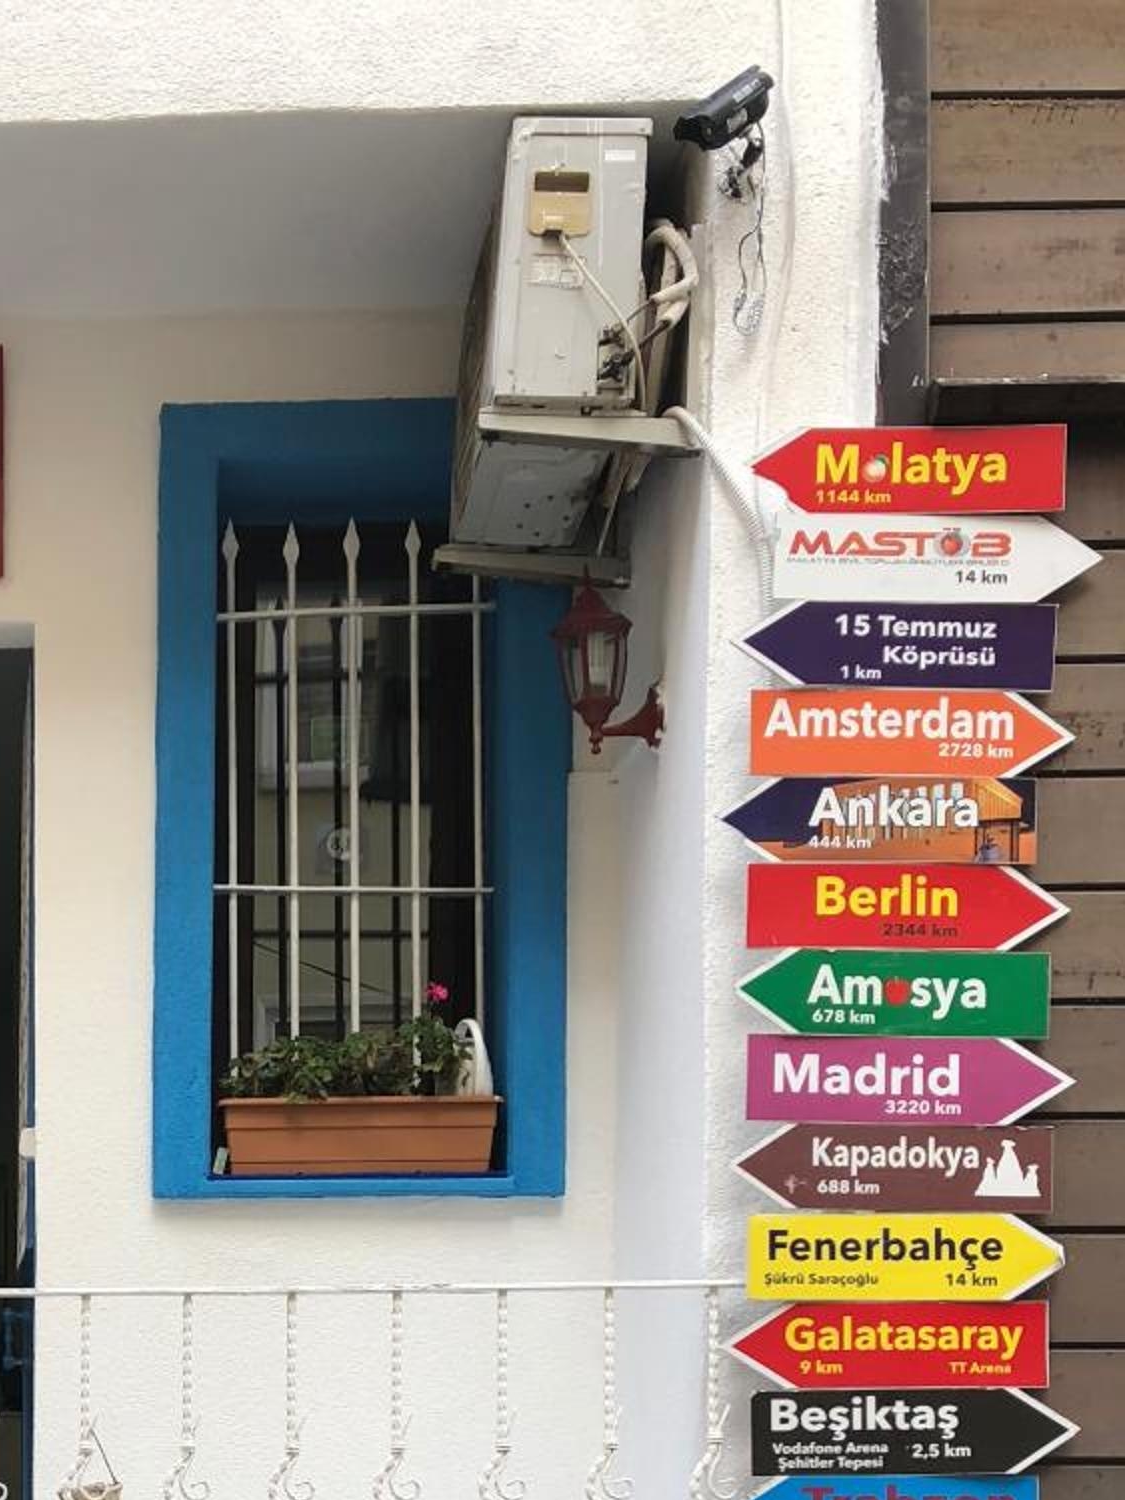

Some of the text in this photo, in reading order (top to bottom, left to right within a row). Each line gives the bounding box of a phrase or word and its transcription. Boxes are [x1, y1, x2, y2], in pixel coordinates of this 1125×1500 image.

[816, 441, 1008, 496] Mlatya
[816, 490, 892, 504] 1144 km
[955, 569, 1008, 584] 14 km
[835, 614, 998, 640] 15 Temmuz
[882, 643, 996, 671] Köprüsü
[840, 666, 882, 680] 1 km
[764, 696, 1015, 741] Amsterdam
[938, 743, 1015, 758] 2728 km
[807, 784, 980, 828] Ankara
[808, 834, 872, 849] 444 km
[815, 873, 958, 917] Berlin
[882, 923, 958, 938] 2344 km
[806, 963, 987, 1020] Amsya
[812, 1010, 876, 1025] 678 km
[772, 1052, 961, 1097] Madrid
[884, 1100, 962, 1116] 3220 km
[811, 1136, 980, 1177] Kapadokya
[817, 1179, 880, 1194] 688 km
[767, 1228, 1004, 1271] Fenerbahçe
[946, 1273, 998, 1287] 14 km
[784, 1315, 1024, 1360] Galatasaray
[798, 1360, 843, 1375] 9 km
[948, 1362, 1012, 1375] TT Arena
[770, 1396, 959, 1440] Beşiktaş
[772, 1442, 888, 1456] Vodafone Arena
[911, 1443, 971, 1460] 2,5 km
[777, 1456, 884, 1472] Şehitler Tepesi
